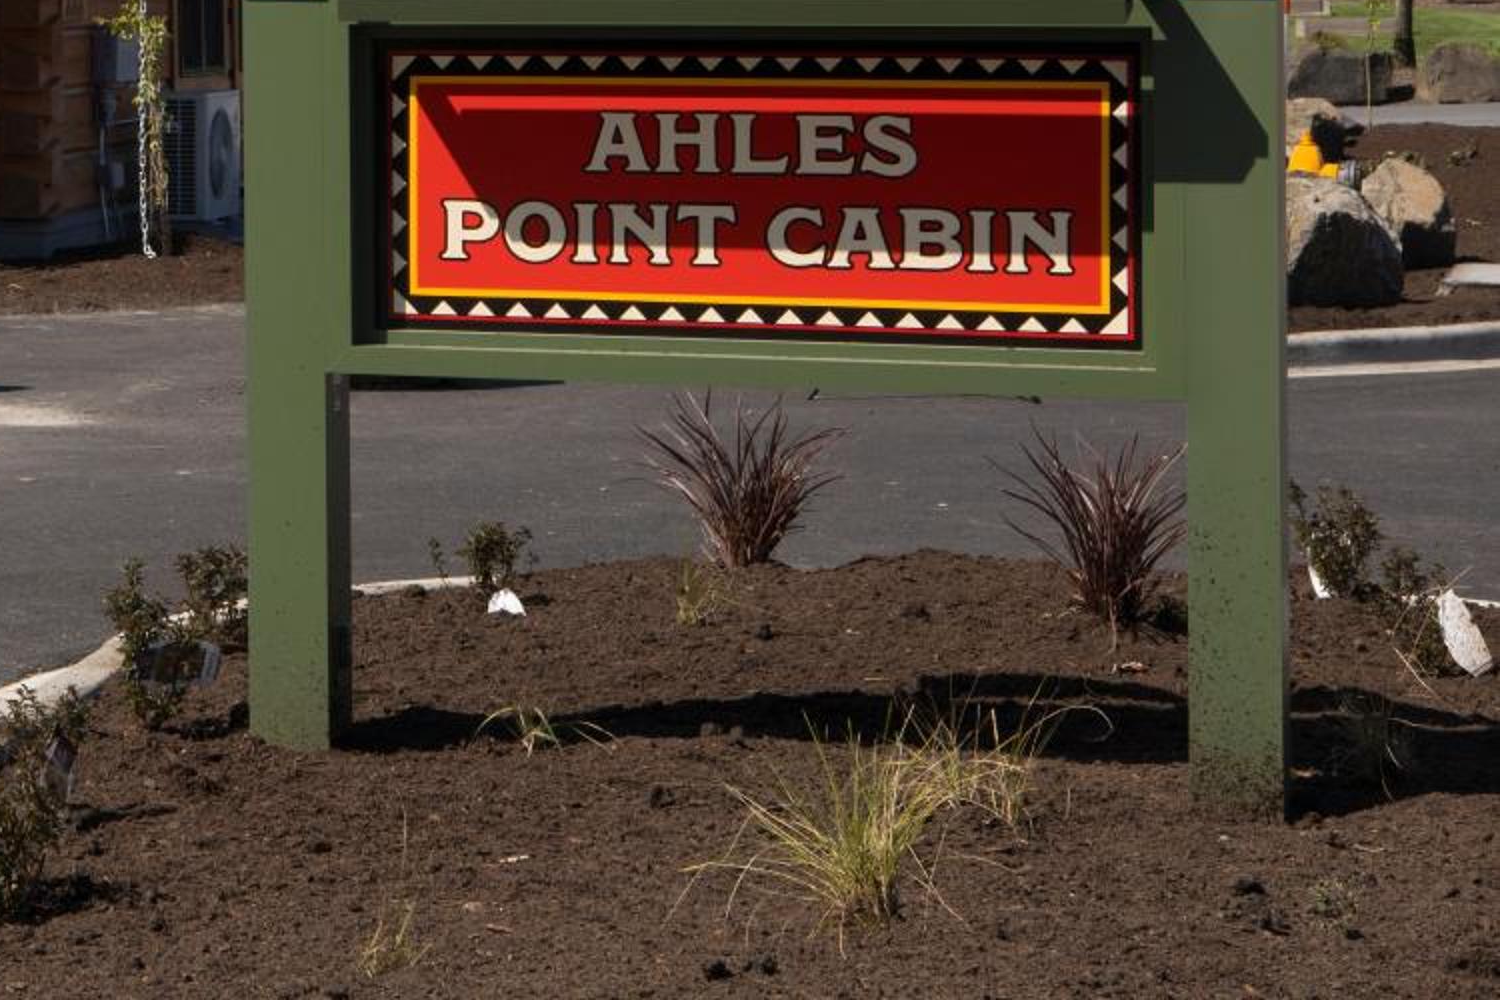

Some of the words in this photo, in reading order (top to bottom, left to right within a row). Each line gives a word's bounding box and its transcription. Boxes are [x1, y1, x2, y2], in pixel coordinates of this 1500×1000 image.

[582, 111, 918, 178] AHLES
[440, 199, 737, 266] POINT
[765, 206, 1075, 275] CABIN
